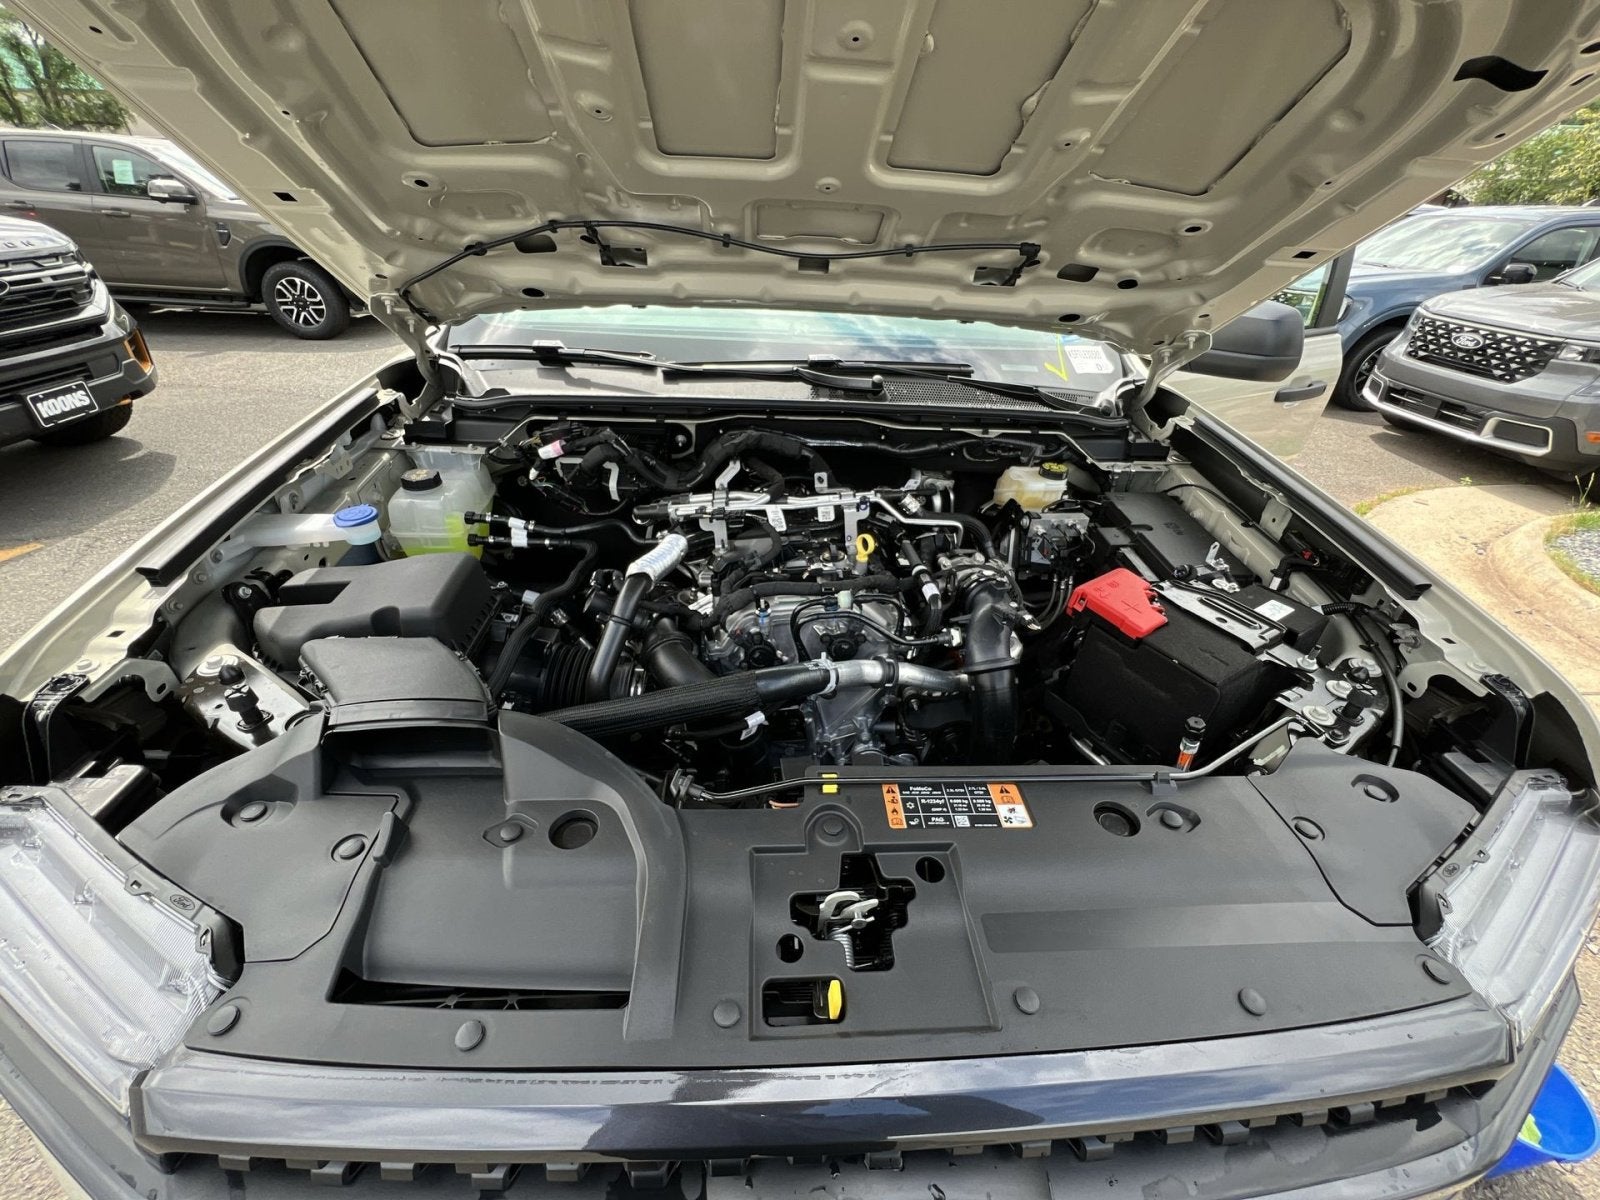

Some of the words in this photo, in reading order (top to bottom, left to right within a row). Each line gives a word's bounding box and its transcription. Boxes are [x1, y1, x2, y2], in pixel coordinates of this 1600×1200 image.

[1455, 335, 1479, 347] Ford
[36, 390, 90, 418] KOONS
[172, 895, 193, 909] Ford
